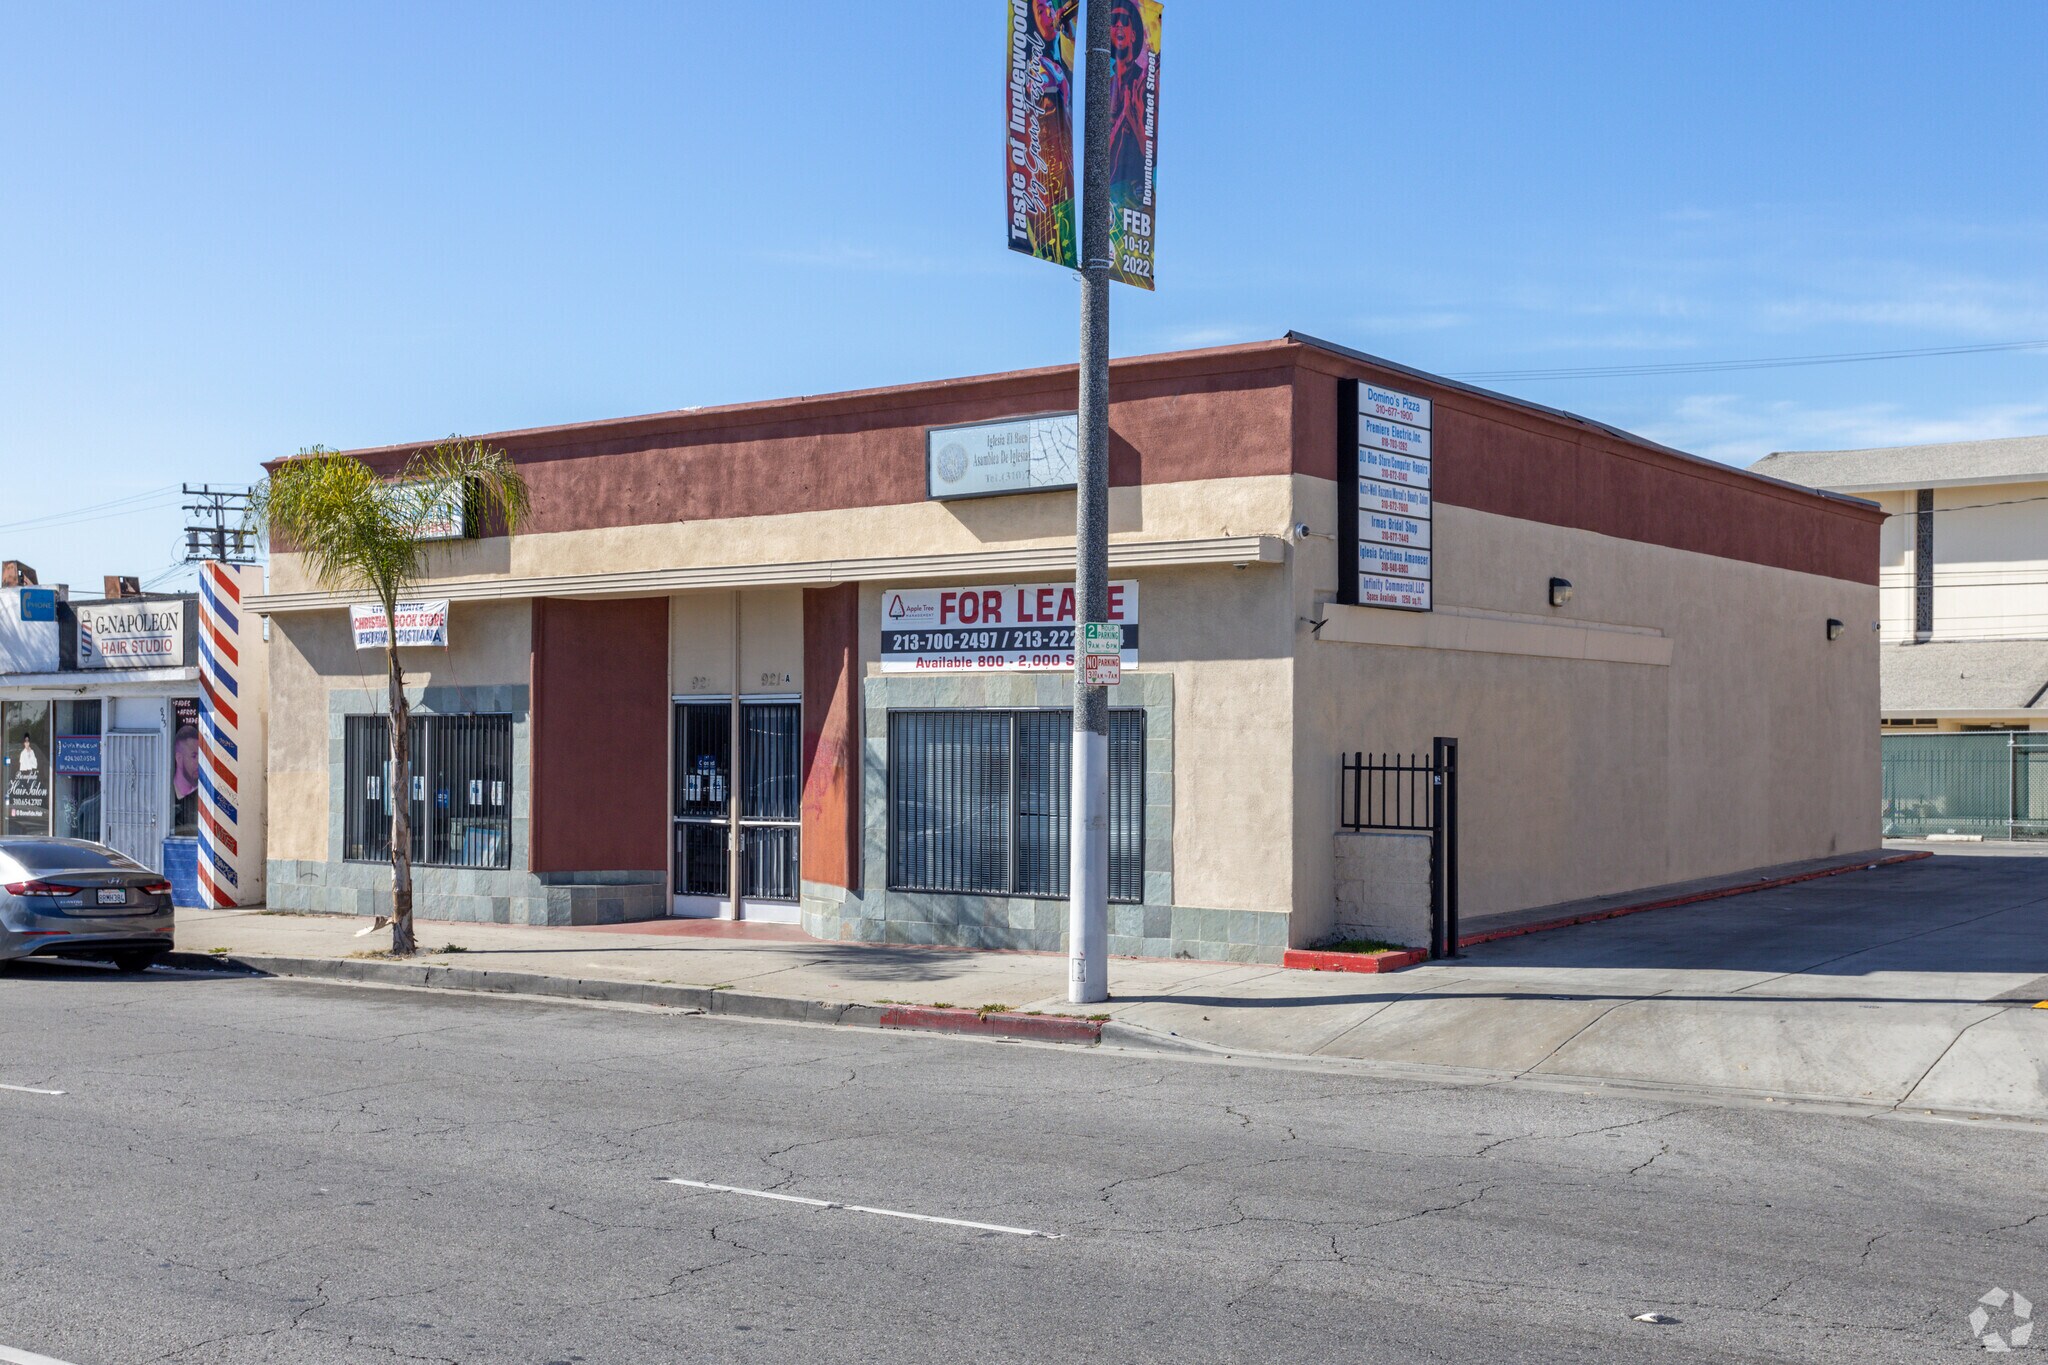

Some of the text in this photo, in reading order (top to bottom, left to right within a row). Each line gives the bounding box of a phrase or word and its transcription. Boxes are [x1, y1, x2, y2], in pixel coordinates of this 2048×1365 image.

[1010, 0, 1029, 241] Taste of Inglewood
[1023, 31, 1048, 215] Big Game Festival
[1142, 51, 1158, 207] Downtown Market Street
[1123, 207, 1151, 238] FEB
[1123, 234, 1150, 257] 10-12
[1122, 255, 1151, 279] 2022
[1367, 387, 1420, 413] Domino's Pizza
[1375, 403, 1414, 421] 310-677-1900
[1366, 420, 1390, 437] Premiere
[987, 433, 1005, 449] Iglesia
[1006, 432, 1014, 444] El
[973, 451, 1000, 467] Asamblea
[1000, 450, 1009, 464] De
[1371, 515, 1418, 535] Irmas Bridal Shop
[1359, 545, 1429, 565] Iglesia Cristiana Amanecer
[1363, 577, 1383, 592] Infinity
[27, 602, 53, 610] PHONE
[940, 585, 1125, 625] FOR LEAE
[1366, 592, 1379, 602] Space
[1379, 593, 1397, 603] Available
[906, 604, 935, 613] Apple Tree
[95, 611, 179, 635] G-NAPOLEON
[419, 611, 445, 628] STORE
[892, 631, 998, 651] 213-700-2497
[1001, 630, 1010, 649] /
[1087, 624, 1096, 638] 2
[1098, 631, 1119, 640] PARKING
[101, 638, 173, 655] HAIR STUDIO
[915, 656, 973, 669] Available
[977, 655, 1005, 668] 800
[1018, 654, 1057, 669] 2,000
[1086, 656, 1119, 669] NO PARKING
